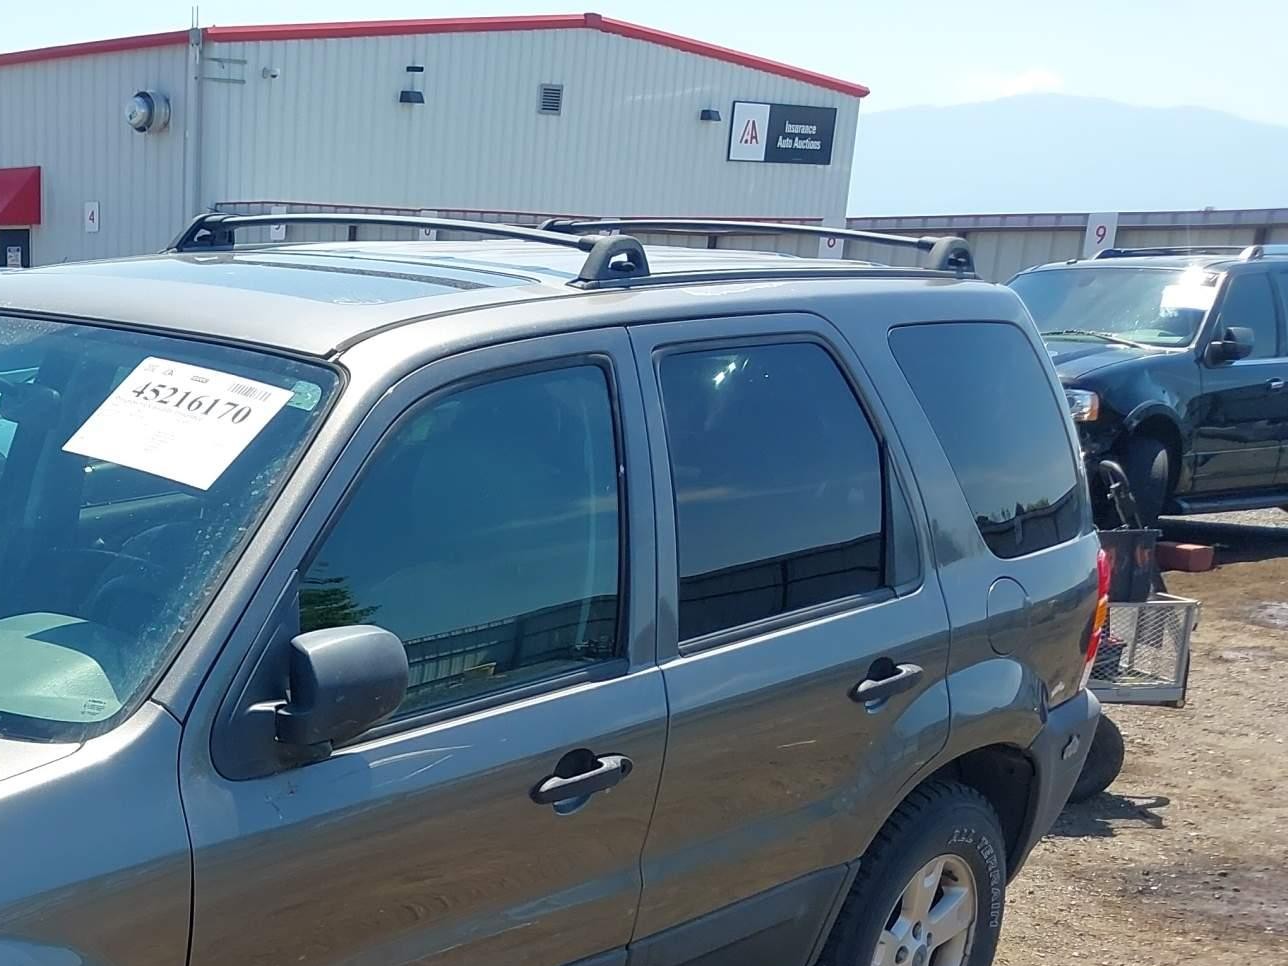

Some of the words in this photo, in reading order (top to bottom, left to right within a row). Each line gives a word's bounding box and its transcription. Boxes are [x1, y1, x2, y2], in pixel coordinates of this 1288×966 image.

[785, 120, 817, 135] Insurance
[776, 135, 793, 149] Auto
[793, 137, 822, 150] Auctions
[88, 210, 95, 224] 4
[1095, 225, 1107, 245] 9
[132, 381, 252, 425] 45216170
